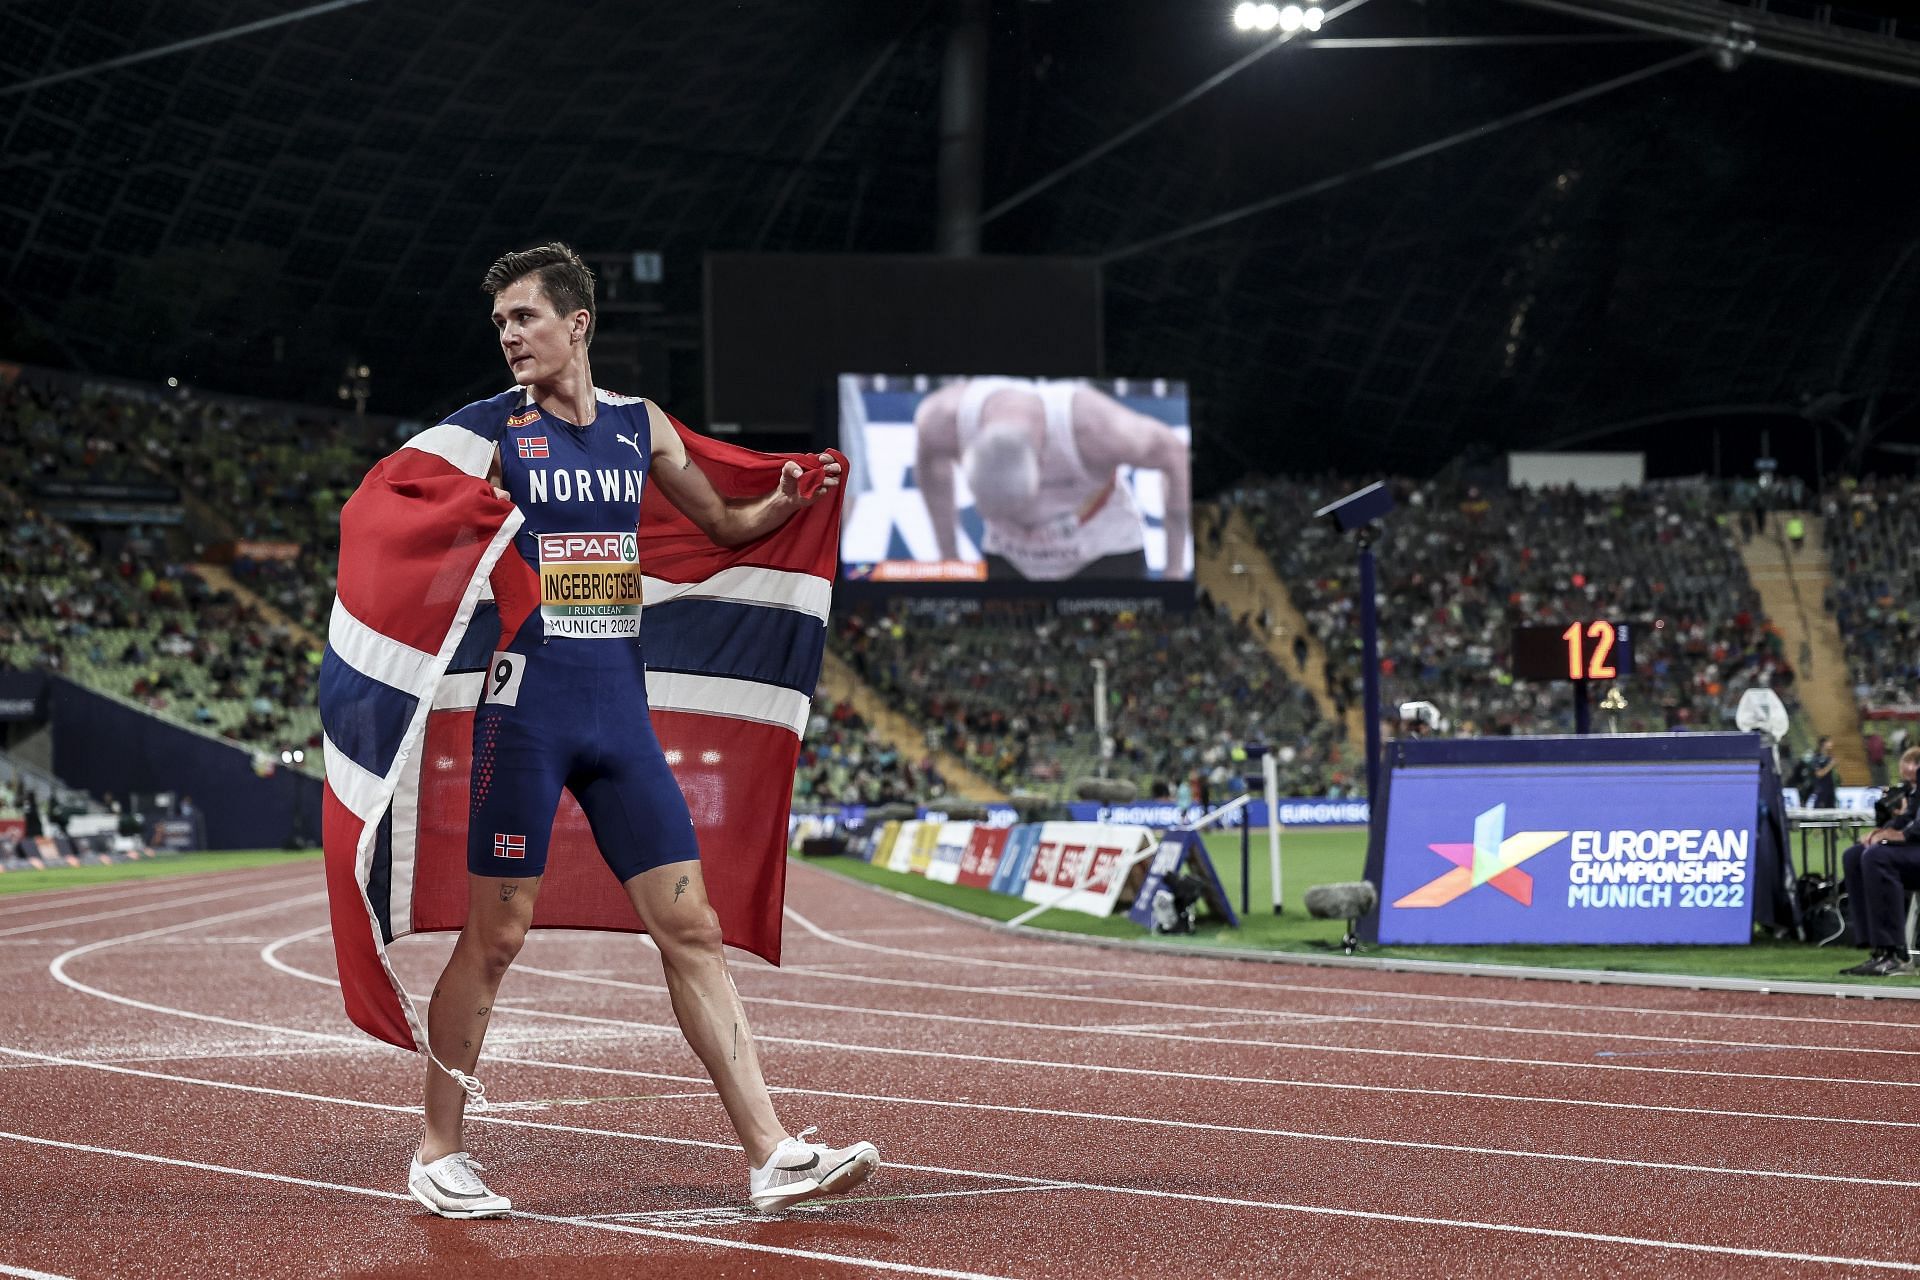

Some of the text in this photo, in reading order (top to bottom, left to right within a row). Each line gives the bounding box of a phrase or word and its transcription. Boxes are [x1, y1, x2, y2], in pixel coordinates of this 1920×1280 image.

[529, 468, 643, 504] NORWAY
[543, 538, 620, 558] SPAR
[544, 572, 641, 601] INGEBRIGTSEN
[574, 606, 596, 615] RUN
[550, 619, 636, 634] MUNICH 2022
[1562, 620, 1617, 680] 12
[493, 659, 513, 697] 9
[1571, 829, 1749, 862] EUROPEAN
[1569, 861, 1746, 884] CHAMPIONSHIPS
[1567, 884, 1745, 908] MUNICH 2022
